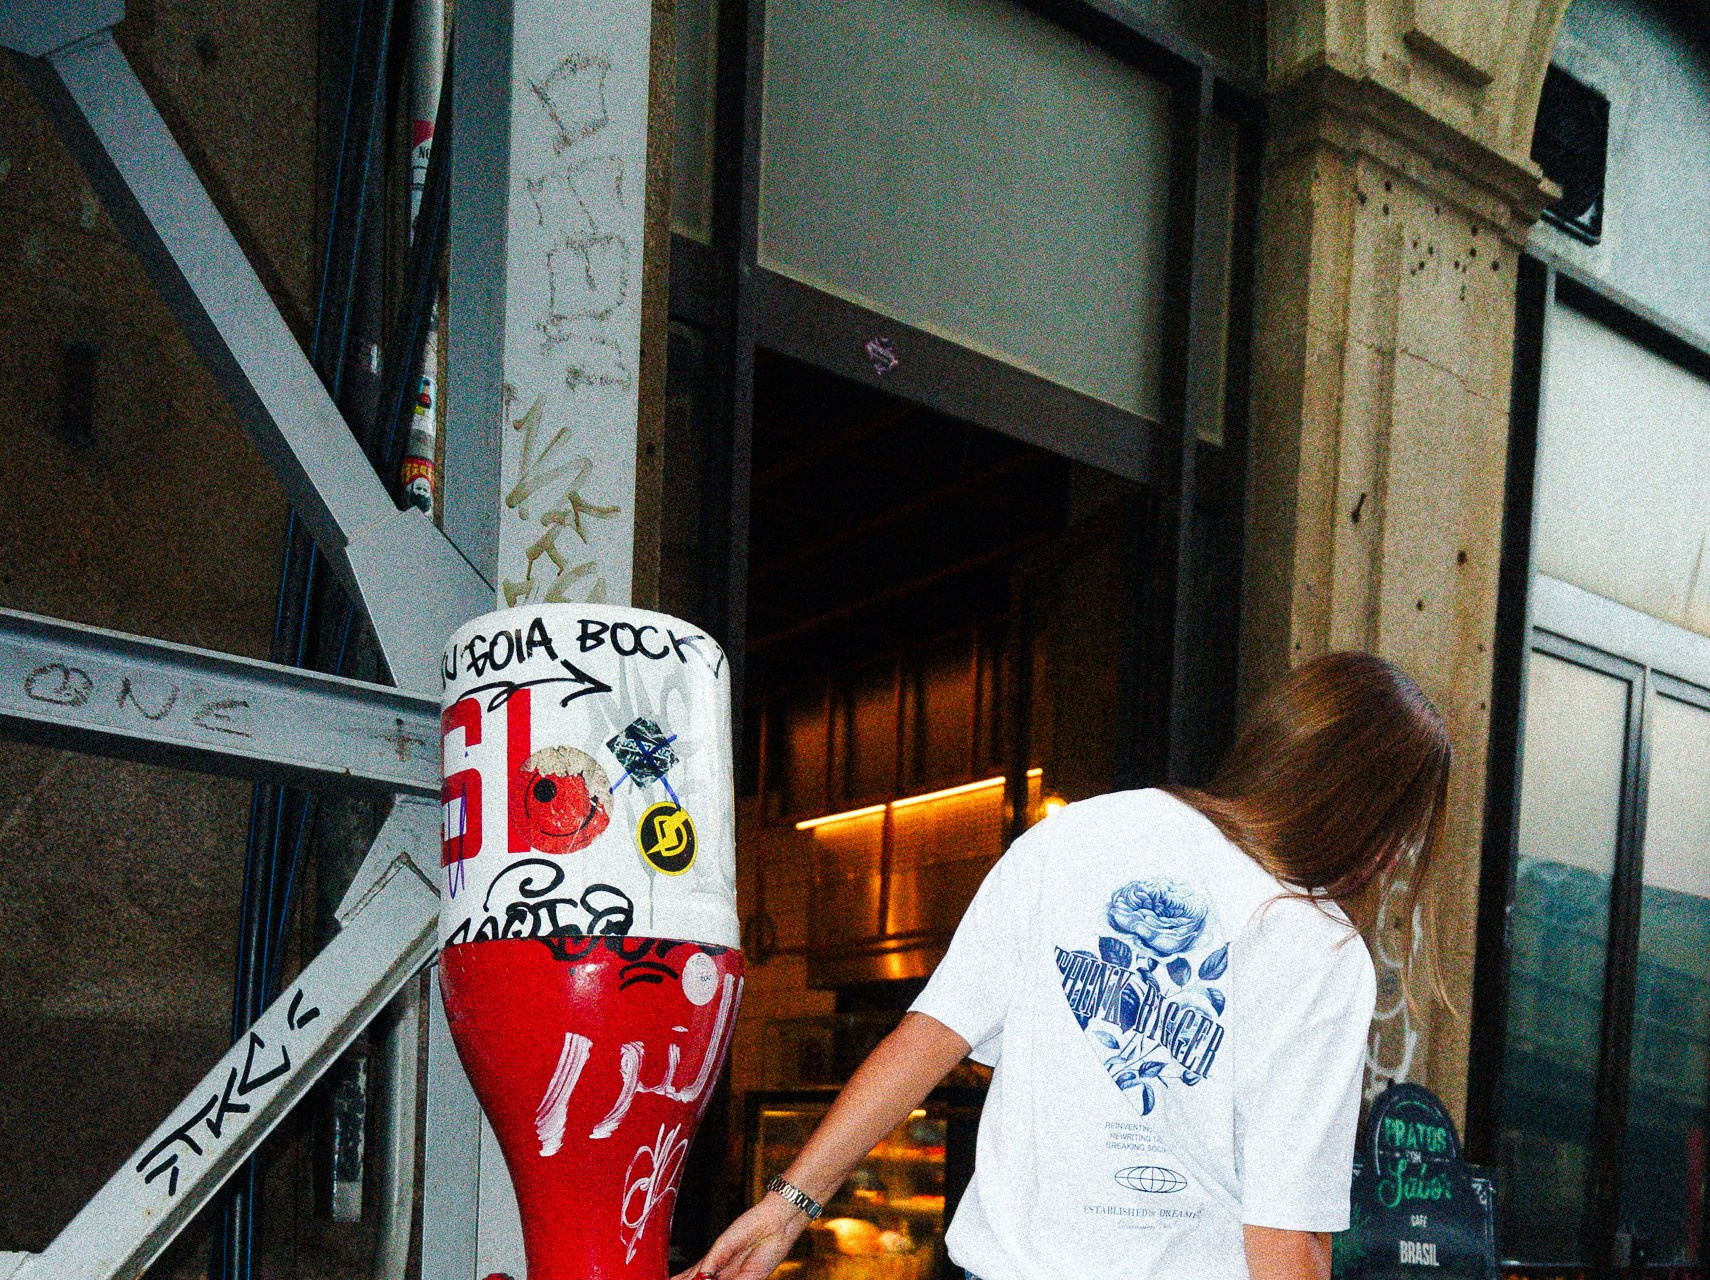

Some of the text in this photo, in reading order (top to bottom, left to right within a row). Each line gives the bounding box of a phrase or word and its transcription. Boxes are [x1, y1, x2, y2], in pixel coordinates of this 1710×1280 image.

[1054, 944, 1225, 1080] THINK BIGGER
[1383, 1117, 1448, 1154] PRATOS
[1400, 1239, 1440, 1267] BRASIL
